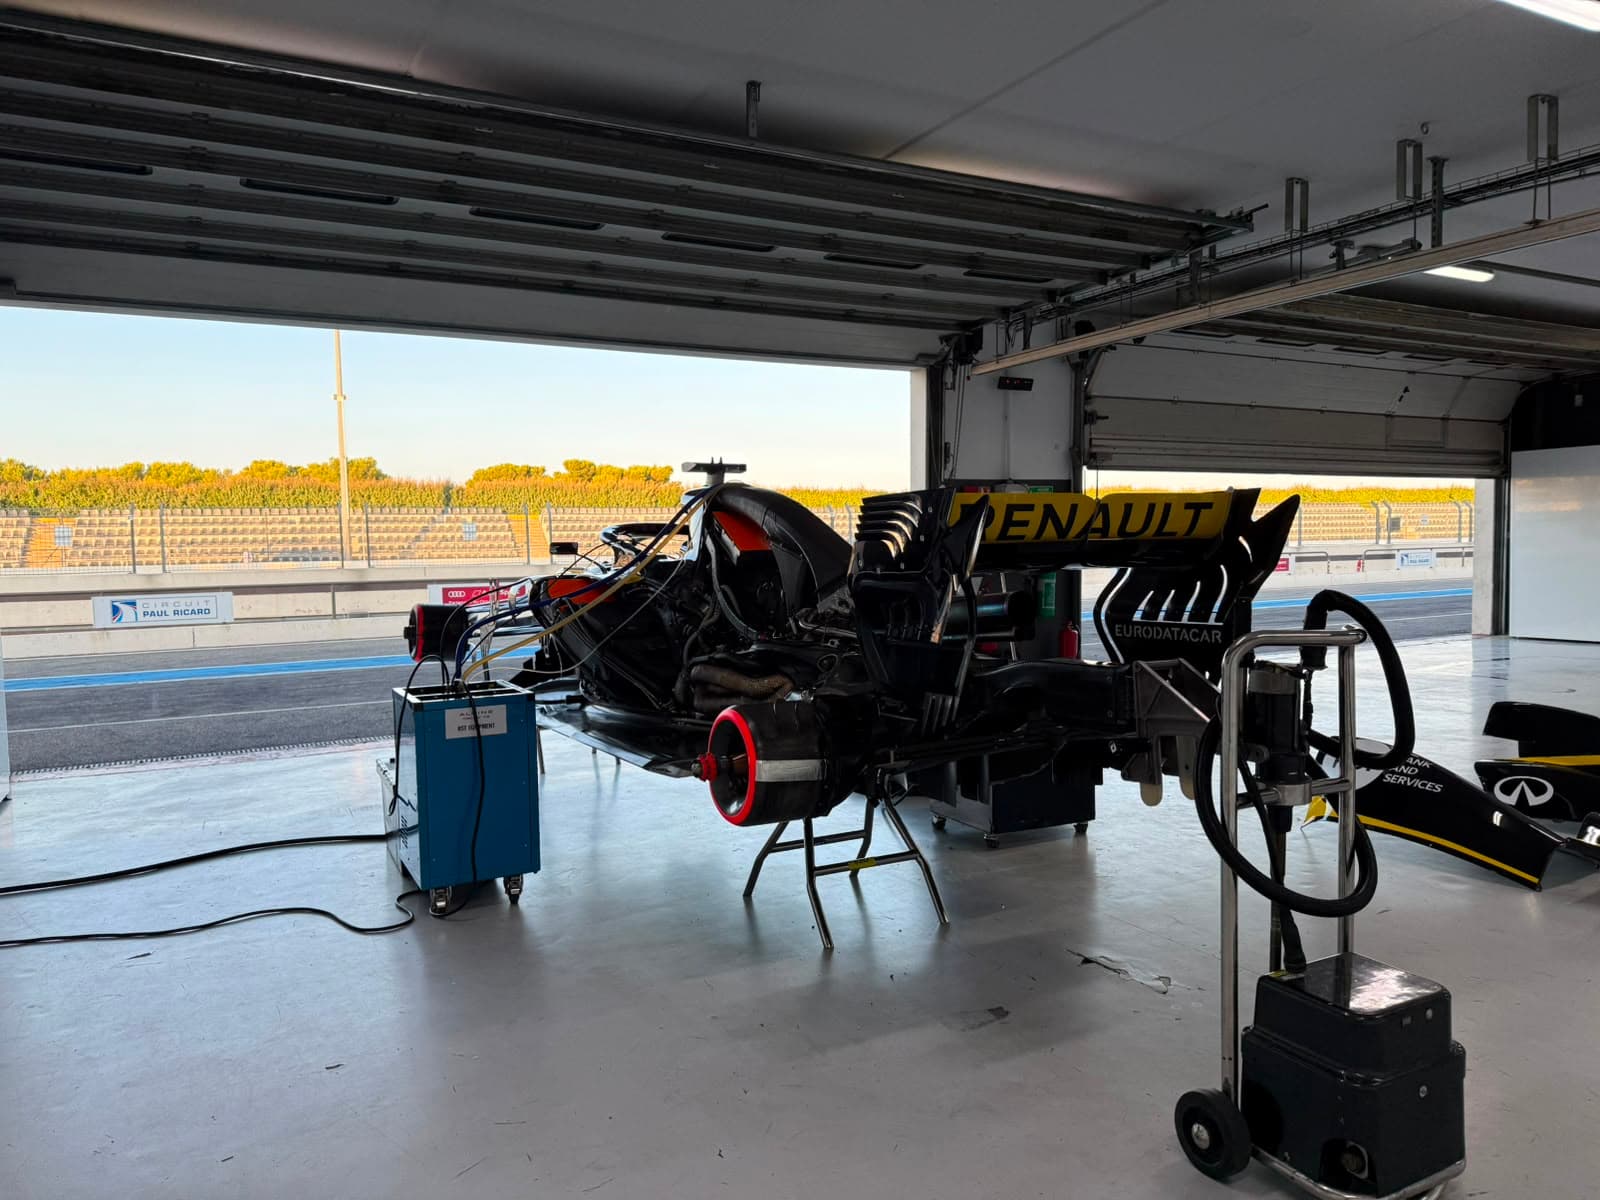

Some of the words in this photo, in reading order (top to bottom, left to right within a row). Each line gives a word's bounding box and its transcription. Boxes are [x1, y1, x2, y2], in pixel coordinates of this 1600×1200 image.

[142, 599, 211, 608] CIRCUIT
[143, 609, 169, 617] PAUL
[173, 608, 211, 617] RICARD
[1115, 624, 1222, 643] EURODATACAR
[1405, 756, 1432, 769] ANK
[1382, 773, 1443, 792] SERVICES
